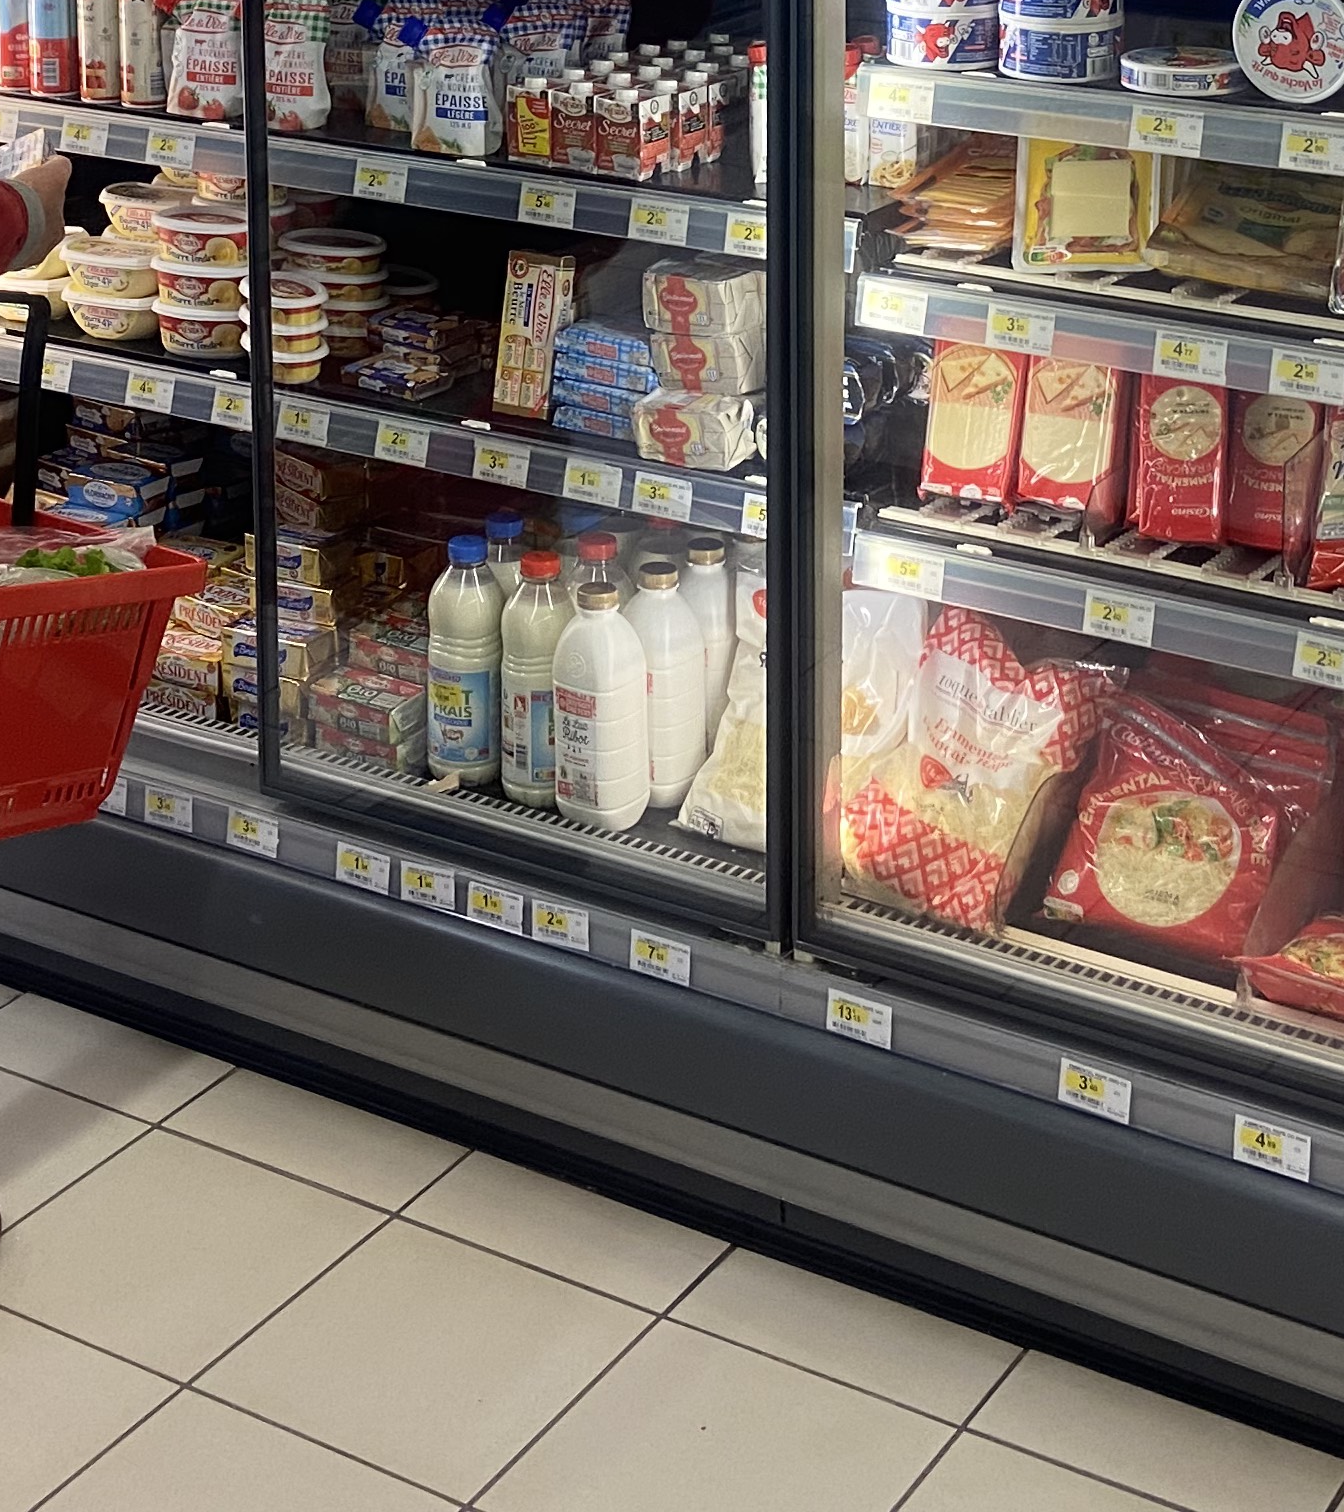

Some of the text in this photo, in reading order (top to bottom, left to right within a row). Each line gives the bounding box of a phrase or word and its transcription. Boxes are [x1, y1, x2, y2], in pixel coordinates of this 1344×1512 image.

[187, 58, 237, 73] ÉPAISSE
[436, 92, 488, 109] ÉPAISSE
[554, 114, 592, 130] Secret
[598, 120, 637, 138] Secret
